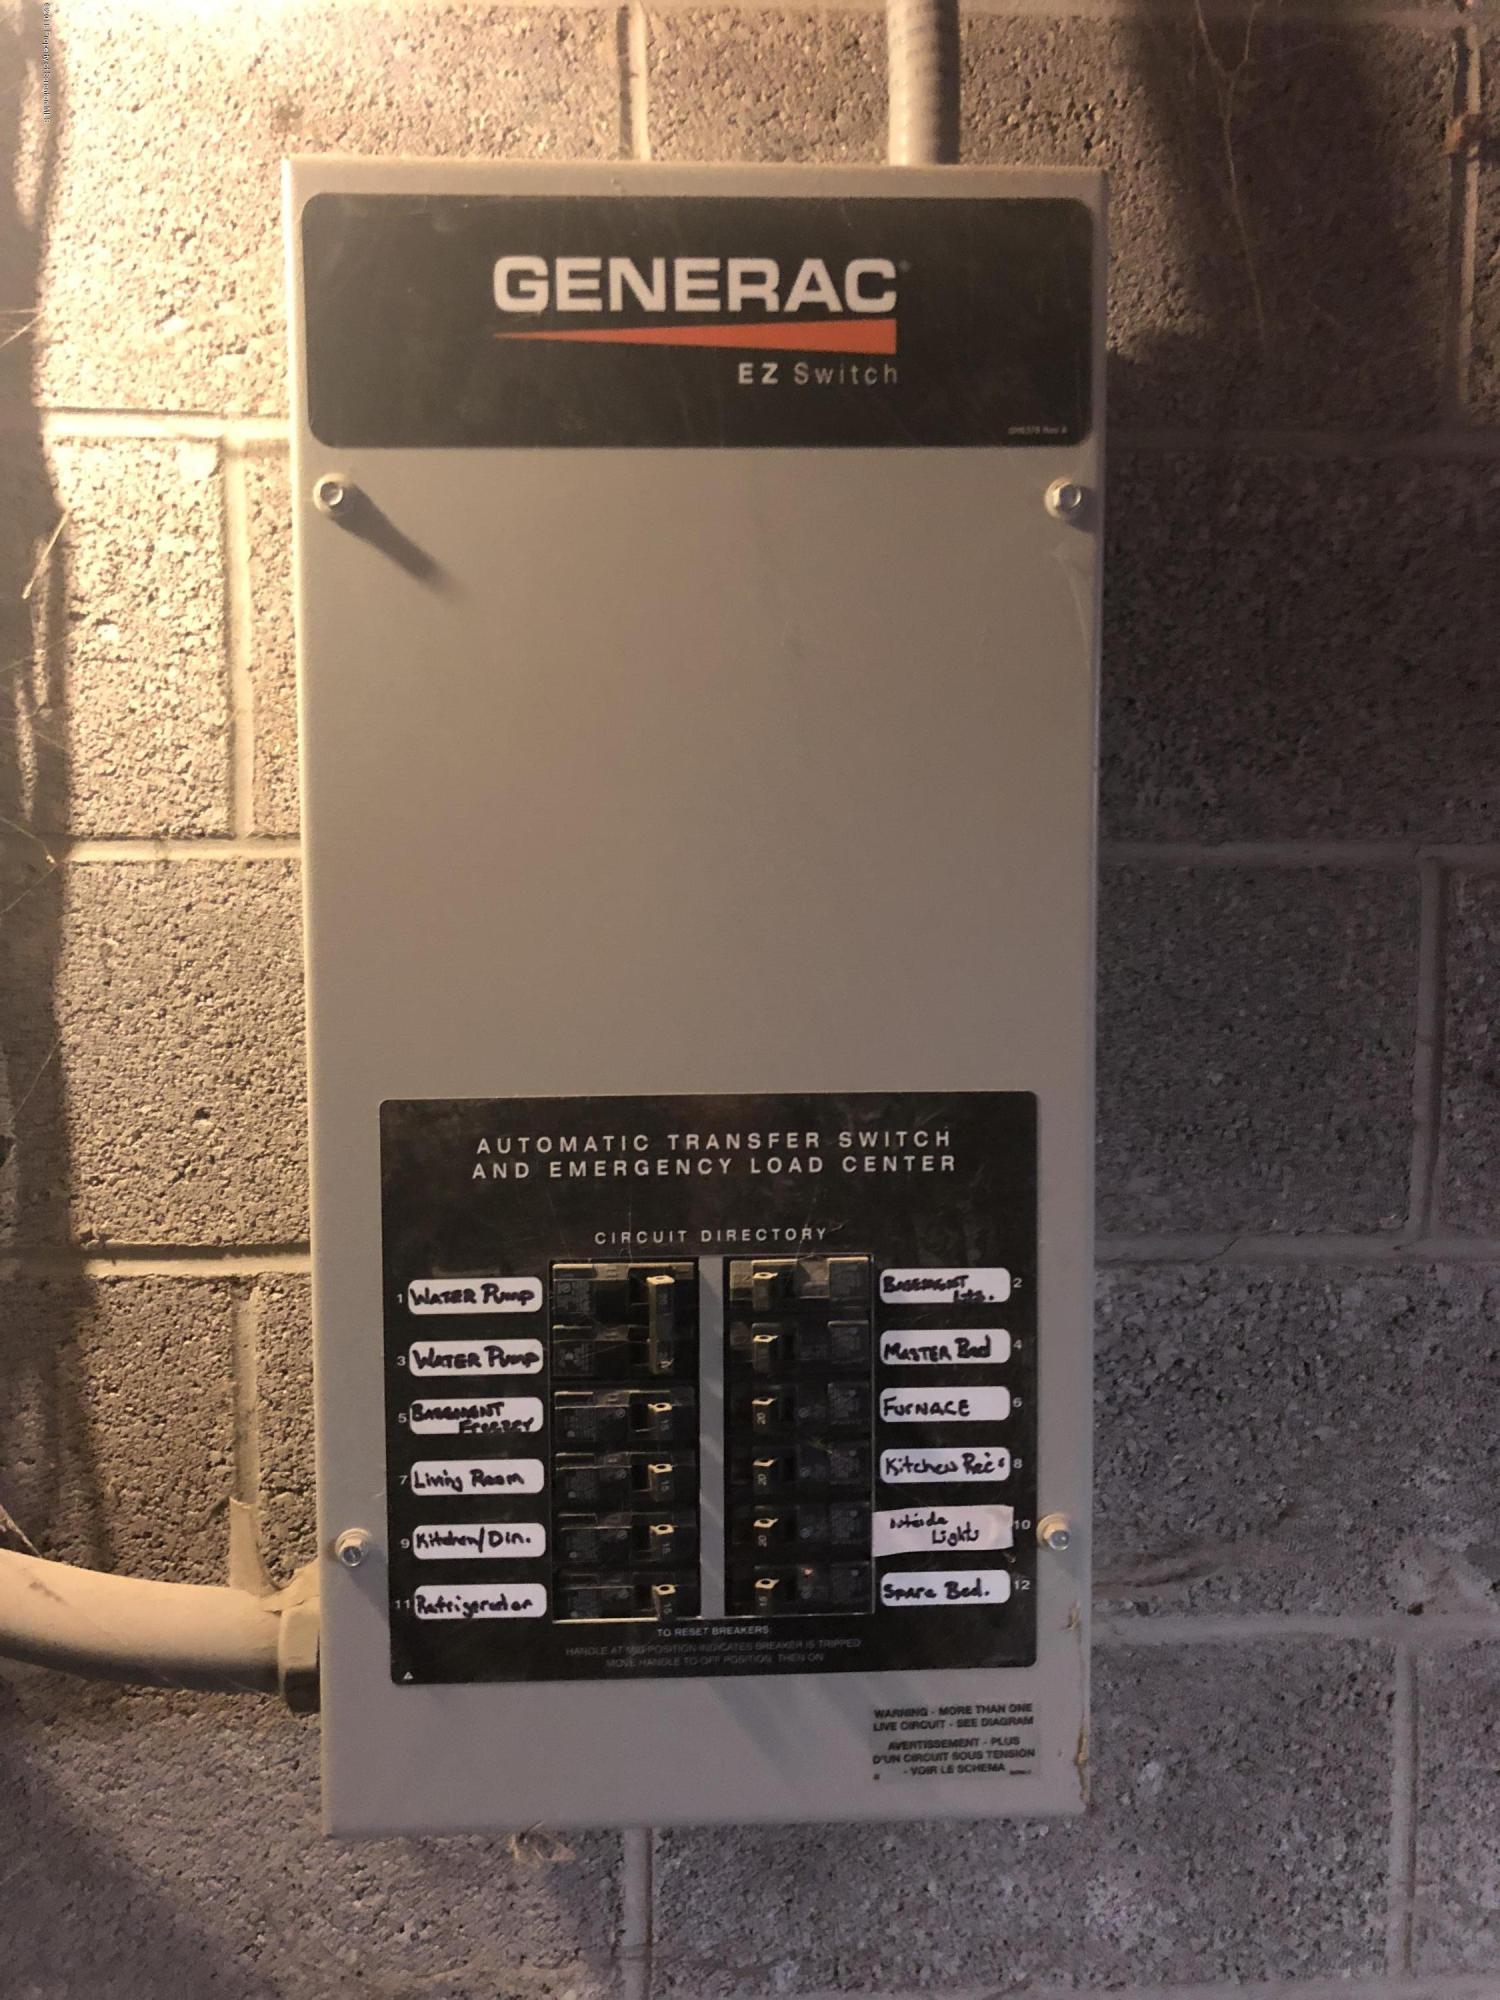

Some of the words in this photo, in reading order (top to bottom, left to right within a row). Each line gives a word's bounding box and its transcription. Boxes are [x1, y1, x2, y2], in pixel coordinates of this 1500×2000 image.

[493, 256, 897, 313] GENERAC
[738, 361, 779, 385] EZ
[793, 361, 898, 386] Switch
[476, 1134, 650, 1154] AUTOMATIC
[667, 1131, 820, 1151] TRANSFER
[839, 1130, 950, 1148] SWITCH
[472, 1162, 530, 1179] AND
[549, 1158, 732, 1178] EMERGENCY
[750, 1156, 823, 1174] LOAD
[842, 1155, 955, 1172] CENTER
[594, 1230, 688, 1245] CIRCUIT
[701, 1228, 827, 1243] DIRECTORY
[1013, 1277, 1023, 1289] 2
[396, 1293, 403, 1304] 1
[1013, 1339, 1022, 1350] 4
[397, 1355, 406, 1367] 3
[398, 1413, 407, 1424] 5
[1013, 1458, 1023, 1469] 8
[400, 1475, 408, 1485] 7
[414, 1469, 463, 1493] Living
[469, 1468, 525, 1488] Room
[1014, 1519, 1031, 1530] 10
[400, 1538, 410, 1549] 9
[1014, 1579, 1031, 1591] 12
[395, 1599, 410, 1609] 11
[657, 1628, 672, 1638] TO
[674, 1627, 708, 1637] RESET
[711, 1625, 769, 1636] BREAKERS
[565, 1646, 609, 1656] HANDLE
[873, 1707, 929, 1719] WARNING
[938, 1705, 972, 1716] MORE
[976, 1704, 1006, 1714] THAN
[1008, 1703, 1033, 1713] ONE
[873, 1721, 897, 1731] LIVE
[900, 1720, 945, 1731] CIRCUIT
[957, 1718, 978, 1728] SEE
[981, 1716, 1034, 1727] DIAGRAM
[888, 1738, 979, 1751] AVERTISSEMENT
[990, 1736, 1021, 1746] PLUS
[872, 1754, 901, 1765] D'UN
[903, 1752, 949, 1763] CIRCUIT
[952, 1750, 983, 1761] SOUS
[986, 1748, 1036, 1759] TENSION
[910, 1765, 937, 1776] VOIR
[941, 1764, 954, 1774] LE
[957, 1763, 1006, 1774] SCHEMA
